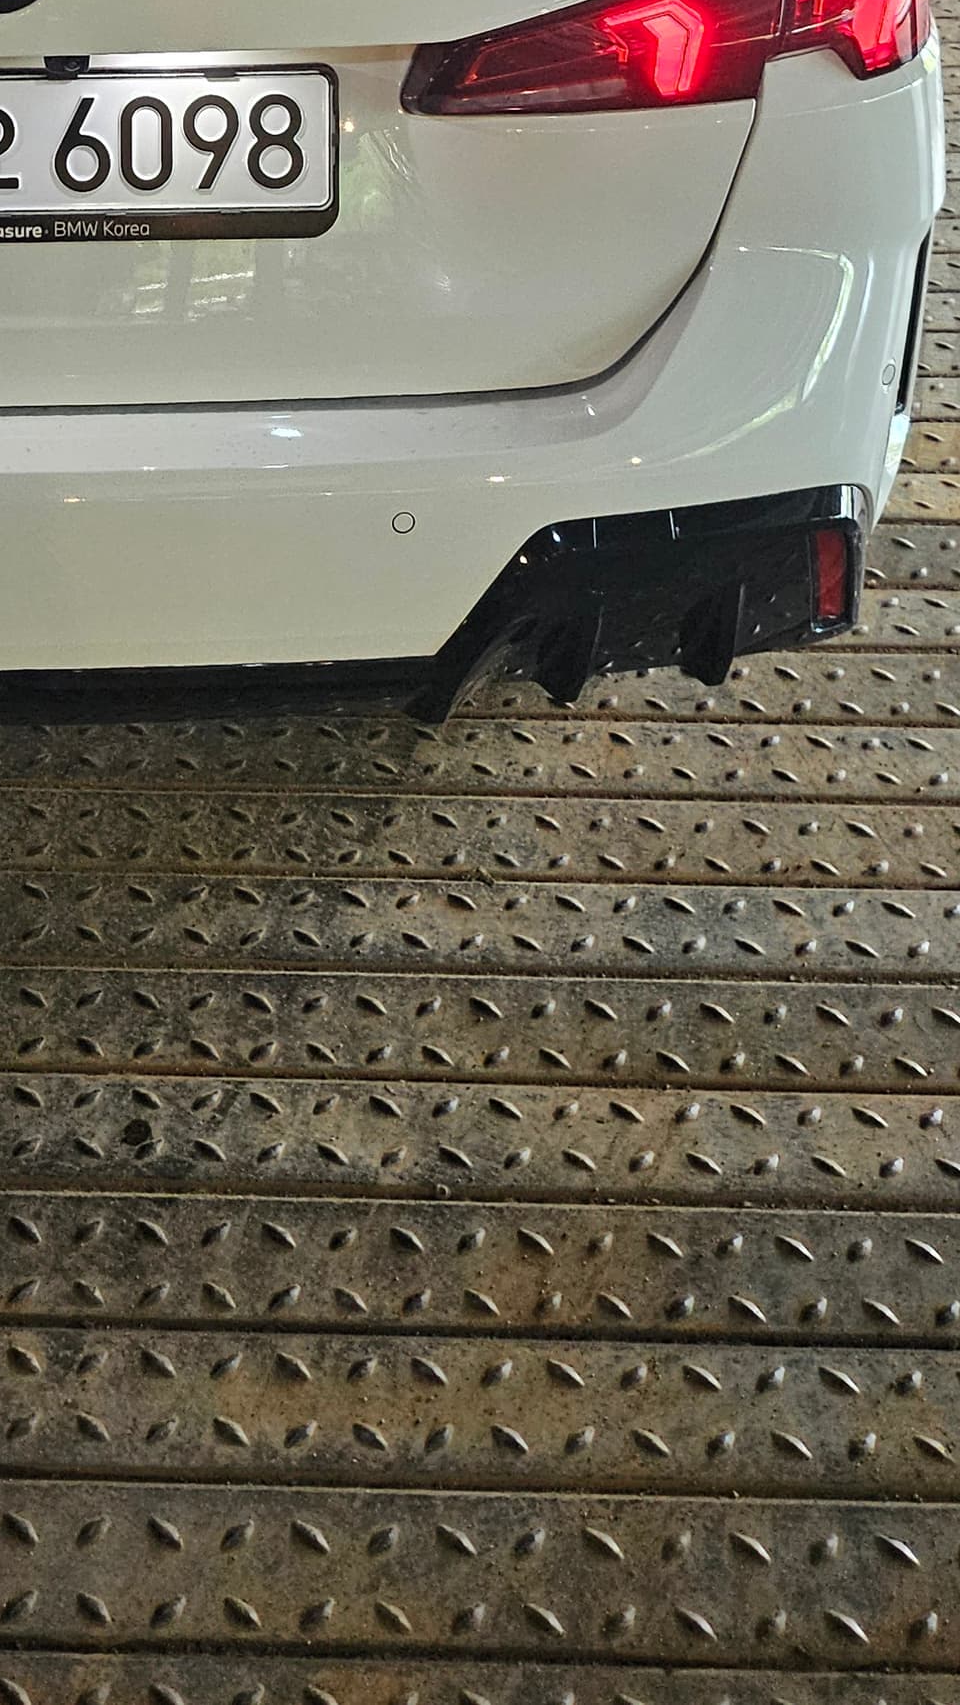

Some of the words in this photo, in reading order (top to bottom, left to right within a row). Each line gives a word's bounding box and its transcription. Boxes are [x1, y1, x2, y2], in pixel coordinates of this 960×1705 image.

[54, 94, 305, 193] 6098
[54, 221, 98, 237] BMW
[103, 220, 150, 236] Korea
